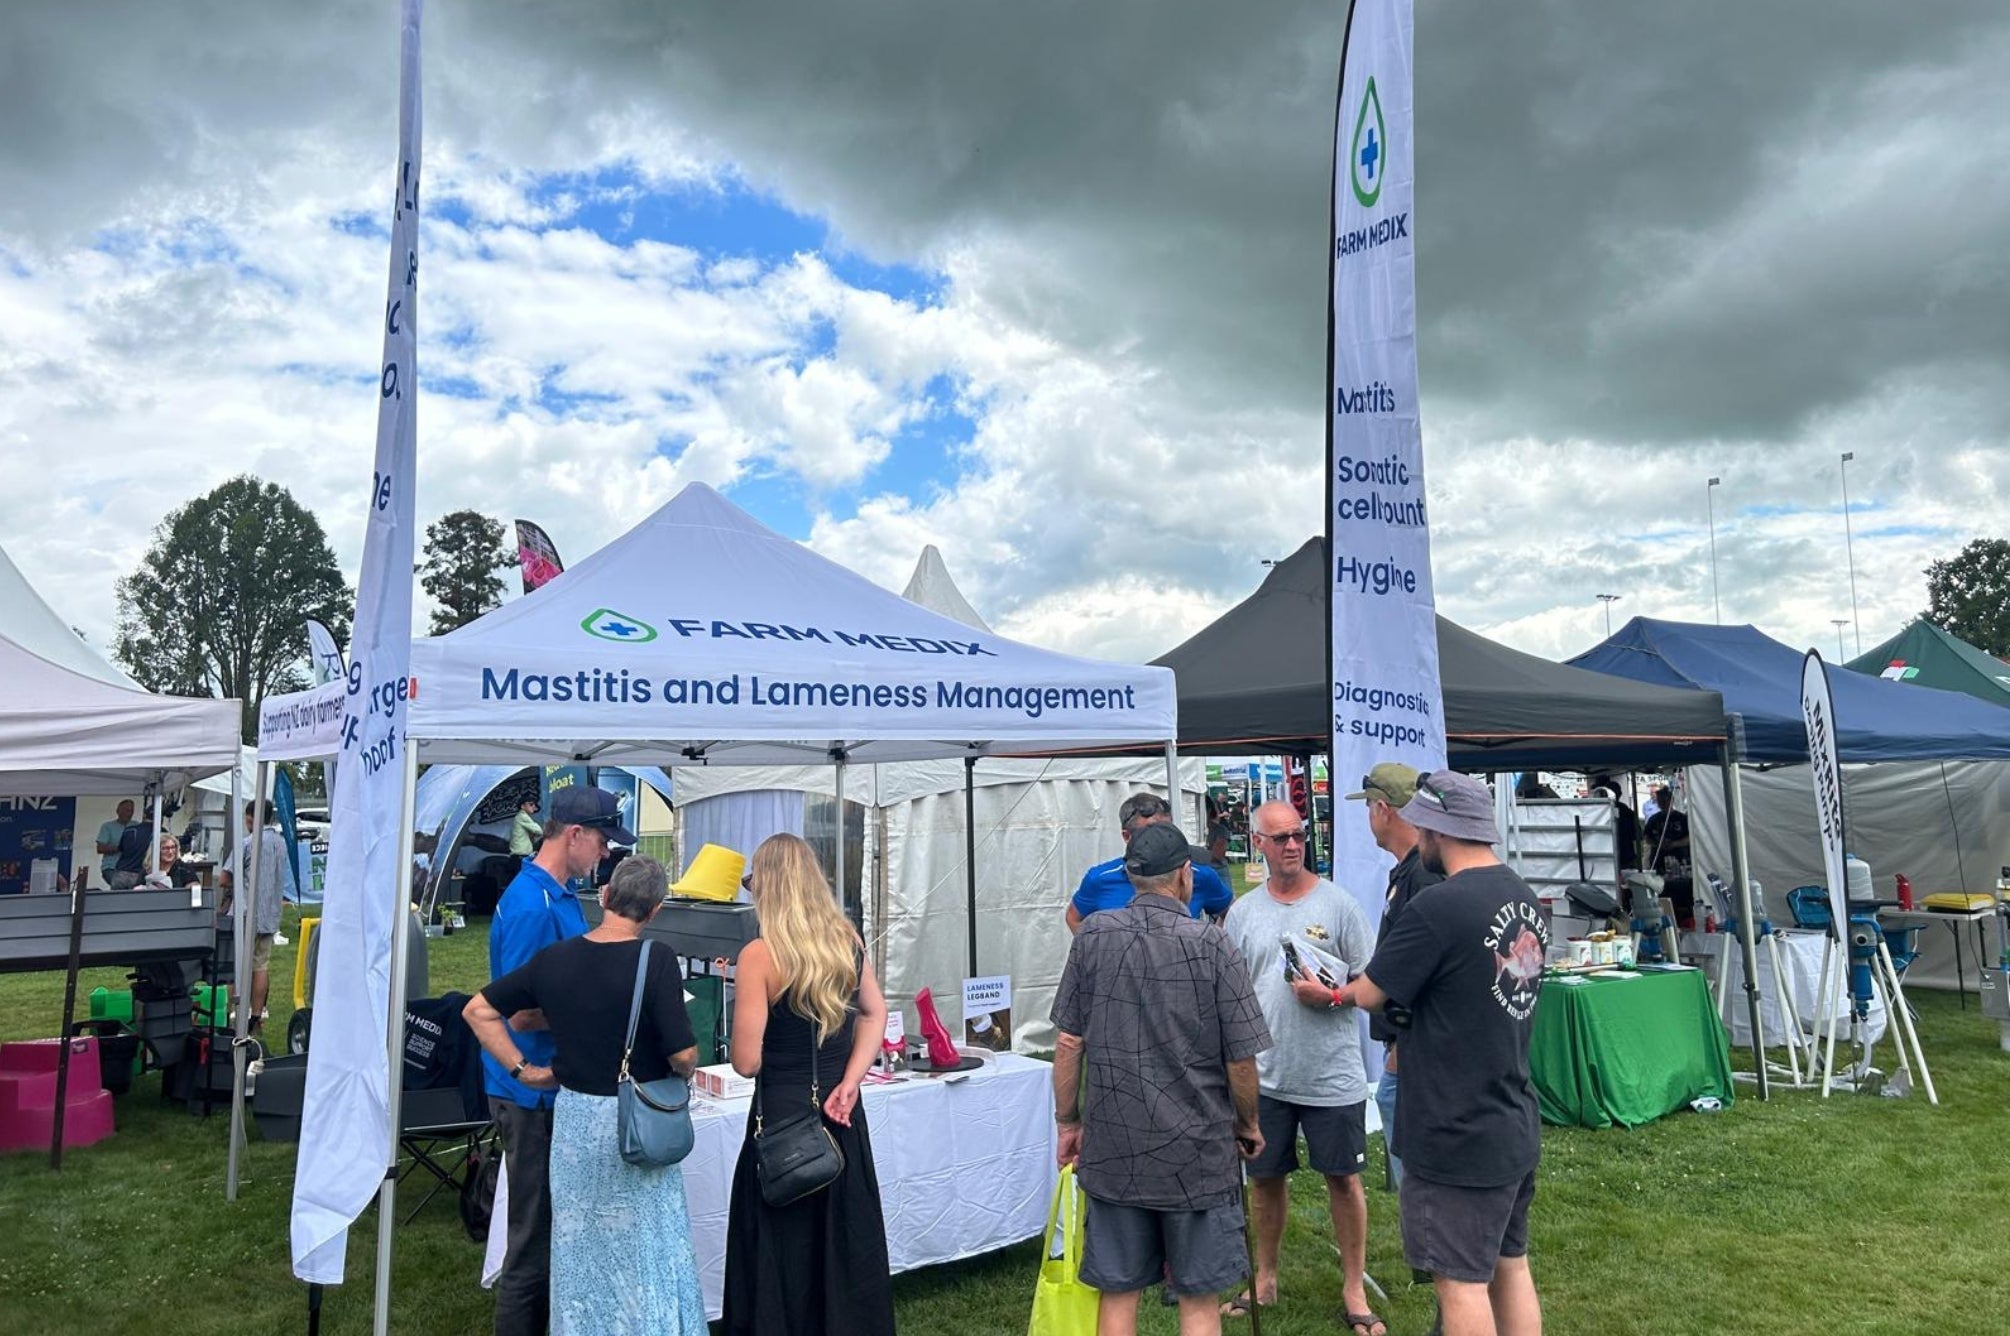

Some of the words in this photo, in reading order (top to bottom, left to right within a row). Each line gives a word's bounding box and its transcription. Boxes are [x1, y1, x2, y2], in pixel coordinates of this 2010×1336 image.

[1337, 229, 1367, 260] FARM
[1369, 212, 1408, 248] MEDIX
[1382, 497, 1426, 527] ount
[668, 618, 831, 643] FARM
[833, 630, 998, 656] MEDIX
[481, 667, 652, 703] Mastitis
[663, 673, 739, 706] and
[751, 675, 927, 708] Lameness
[936, 680, 1135, 718] Management
[263, 707, 290, 739] Supporting
[291, 704, 299, 729] NZ
[300, 698, 316, 736] dairy
[1484, 901, 1517, 950] SALTY
[1519, 902, 1549, 945] CREW
[967, 982, 1004, 991] LAMENESS
[967, 991, 1000, 1001] LEGBAND
[1491, 984, 1508, 1006] FIND
